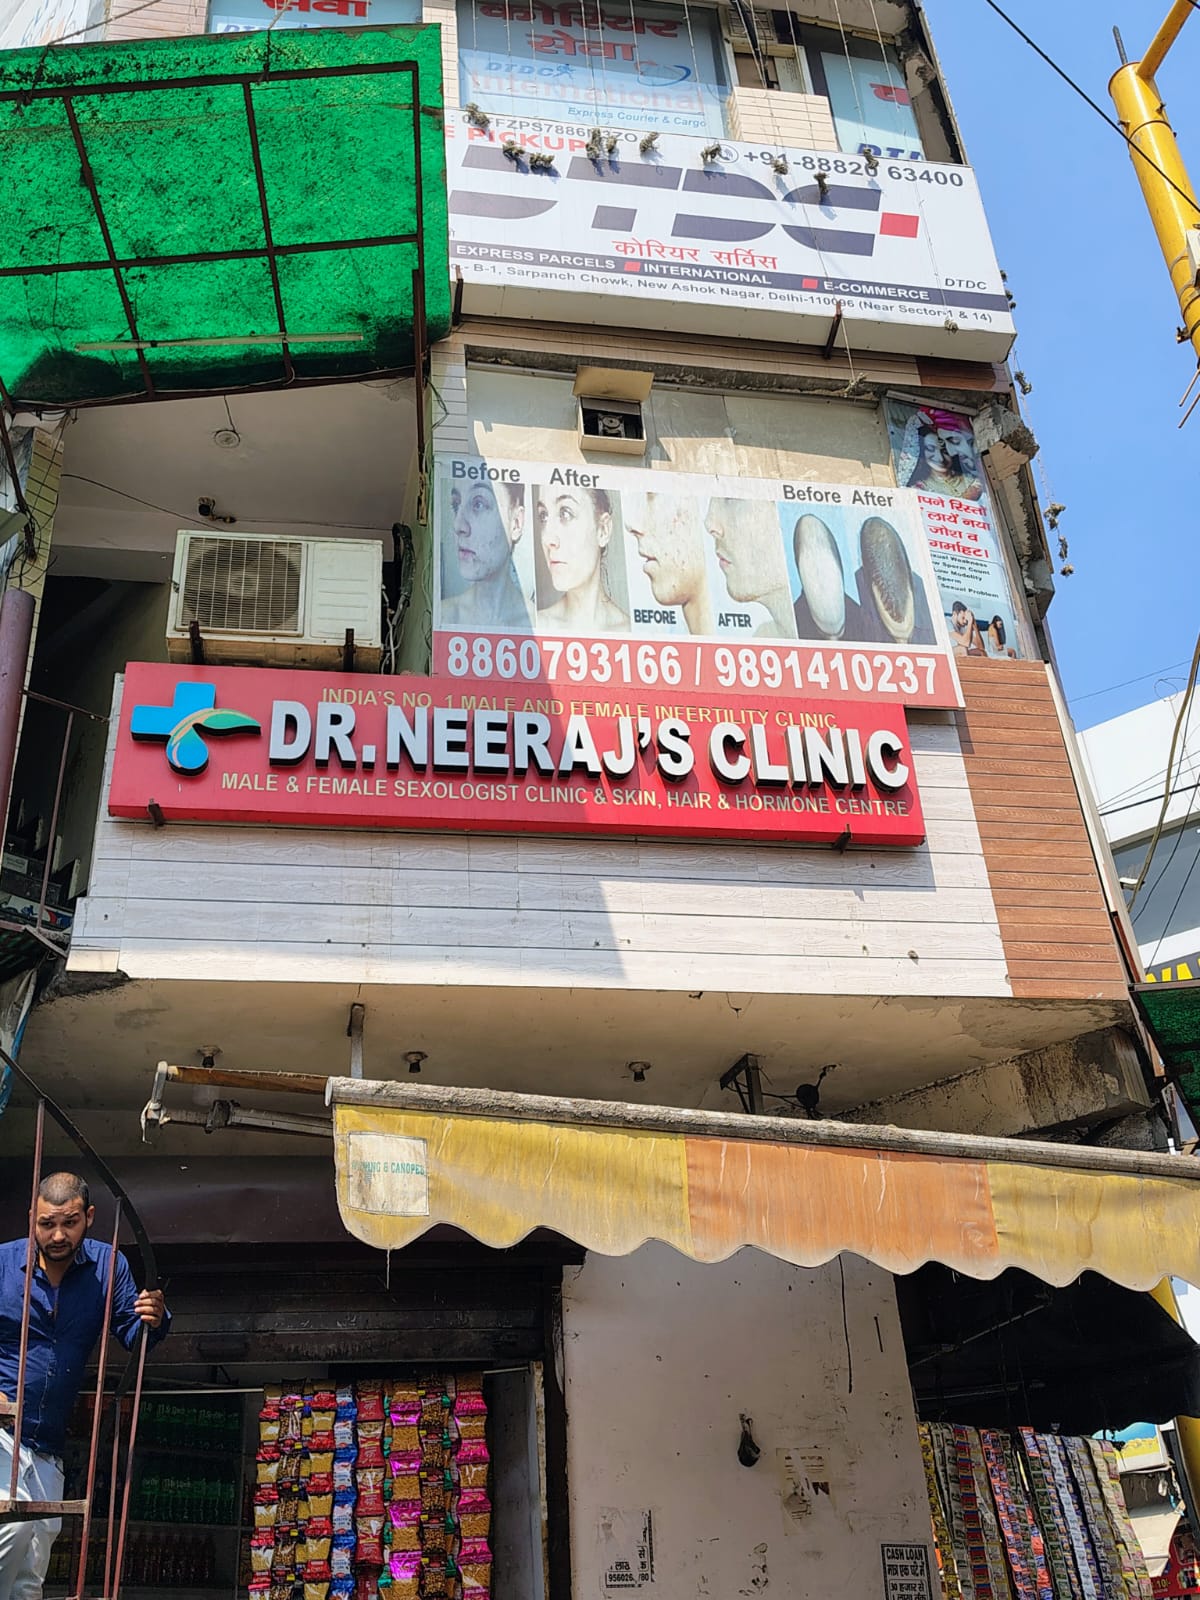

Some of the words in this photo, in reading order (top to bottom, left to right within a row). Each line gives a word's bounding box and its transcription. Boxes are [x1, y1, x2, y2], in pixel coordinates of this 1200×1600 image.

[526, 29, 637, 61] सेवा
[485, 61, 551, 77] DTDC
[471, 70, 705, 113] International
[568, 106, 613, 120] Express
[617, 111, 659, 124] Courier
[662, 115, 670, 124] &
[674, 116, 707, 128] Cargo
[467, 126, 586, 152] PICKUP
[887, 165, 963, 187] 63400
[611, 237, 701, 263] कोरियर
[710, 247, 778, 270] सर्विस
[456, 244, 534, 261] EXPRESS
[539, 253, 616, 270] PARCELS
[644, 263, 772, 285] INTERNATIONAL
[823, 280, 930, 300] E-COMMERCE
[944, 278, 987, 290] DTDC
[506, 266, 575, 280] Sarpanch
[580, 273, 633, 288] Chowk,
[637, 279, 667, 290] New
[671, 282, 716, 295] Ashok
[720, 287, 765, 300] Nagar,
[858, 301, 894, 313] (Near
[899, 304, 953, 318] Sector-1
[958, 311, 968, 319] &
[973, 312, 992, 323] 14)
[451, 460, 521, 482] Before
[549, 467, 600, 488] After
[783, 484, 842, 504] Before
[852, 489, 893, 507] After
[633, 609, 677, 625] BEFORE
[718, 613, 752, 628] AFTER
[447, 636, 682, 686] 8860793166
[714, 647, 937, 695] 9891410237
[322, 687, 396, 707] INDIA'S
[461, 694, 517, 712] MALE
[522, 698, 564, 715] AND
[570, 701, 649, 719] FEMALE
[655, 704, 769, 727] INFERTILITY
[774, 711, 838, 729] CLINIC
[708, 720, 910, 792] CLINIC
[222, 772, 279, 792] MALE
[285, 776, 300, 793] &
[306, 777, 388, 797] FEMALE
[394, 779, 519, 802] SEXOLOGIST
[525, 785, 588, 805] CLINIC
[594, 788, 607, 805] &
[612, 789, 663, 810] SKIN,
[667, 792, 712, 810] HAIR
[718, 793, 731, 810] &
[735, 794, 831, 815] HORMONE
[835, 798, 910, 818] CENTRE
[886, 1547, 904, 1560] CASH
[905, 1548, 923, 1561] LOAN
